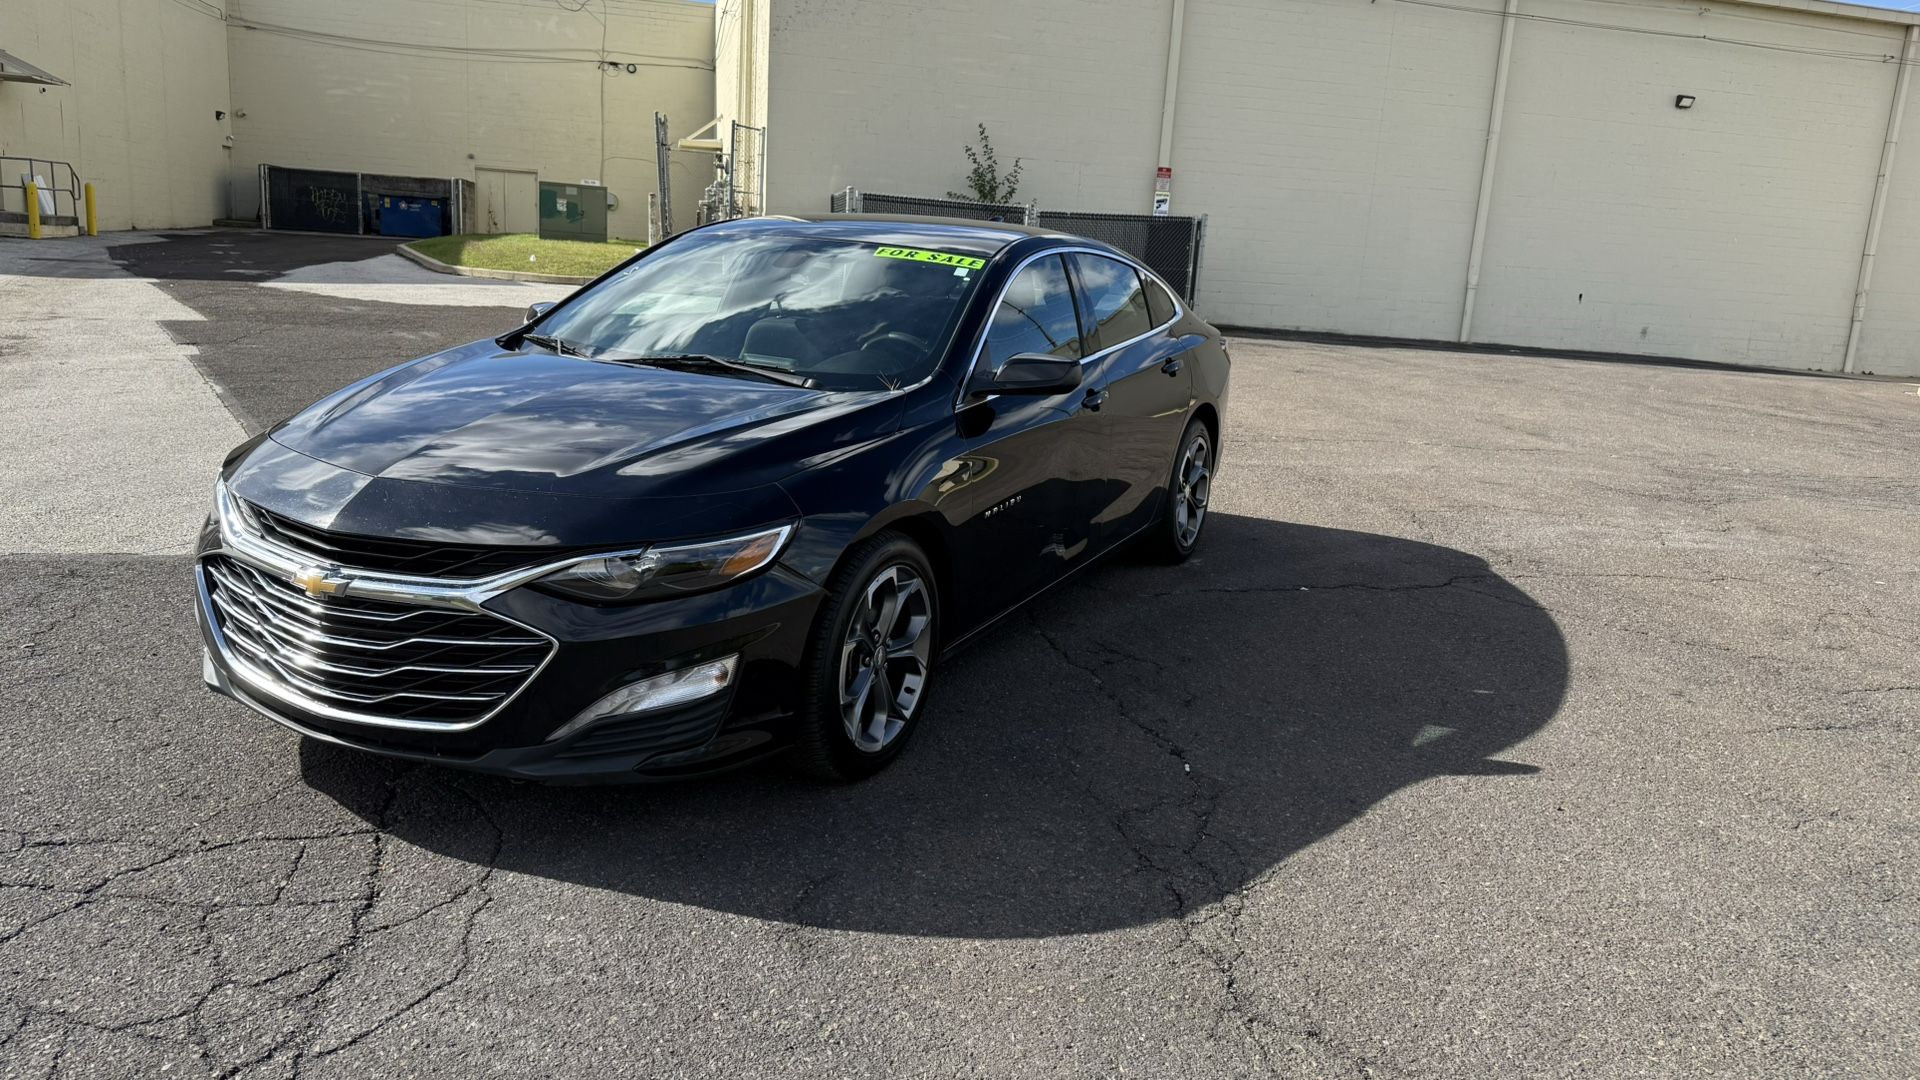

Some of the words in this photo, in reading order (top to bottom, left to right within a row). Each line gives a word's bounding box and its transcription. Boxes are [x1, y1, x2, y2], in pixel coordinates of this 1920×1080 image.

[876, 248, 918, 258] FOR
[927, 253, 981, 267] SALE
[984, 495, 1022, 519] MALIBU
